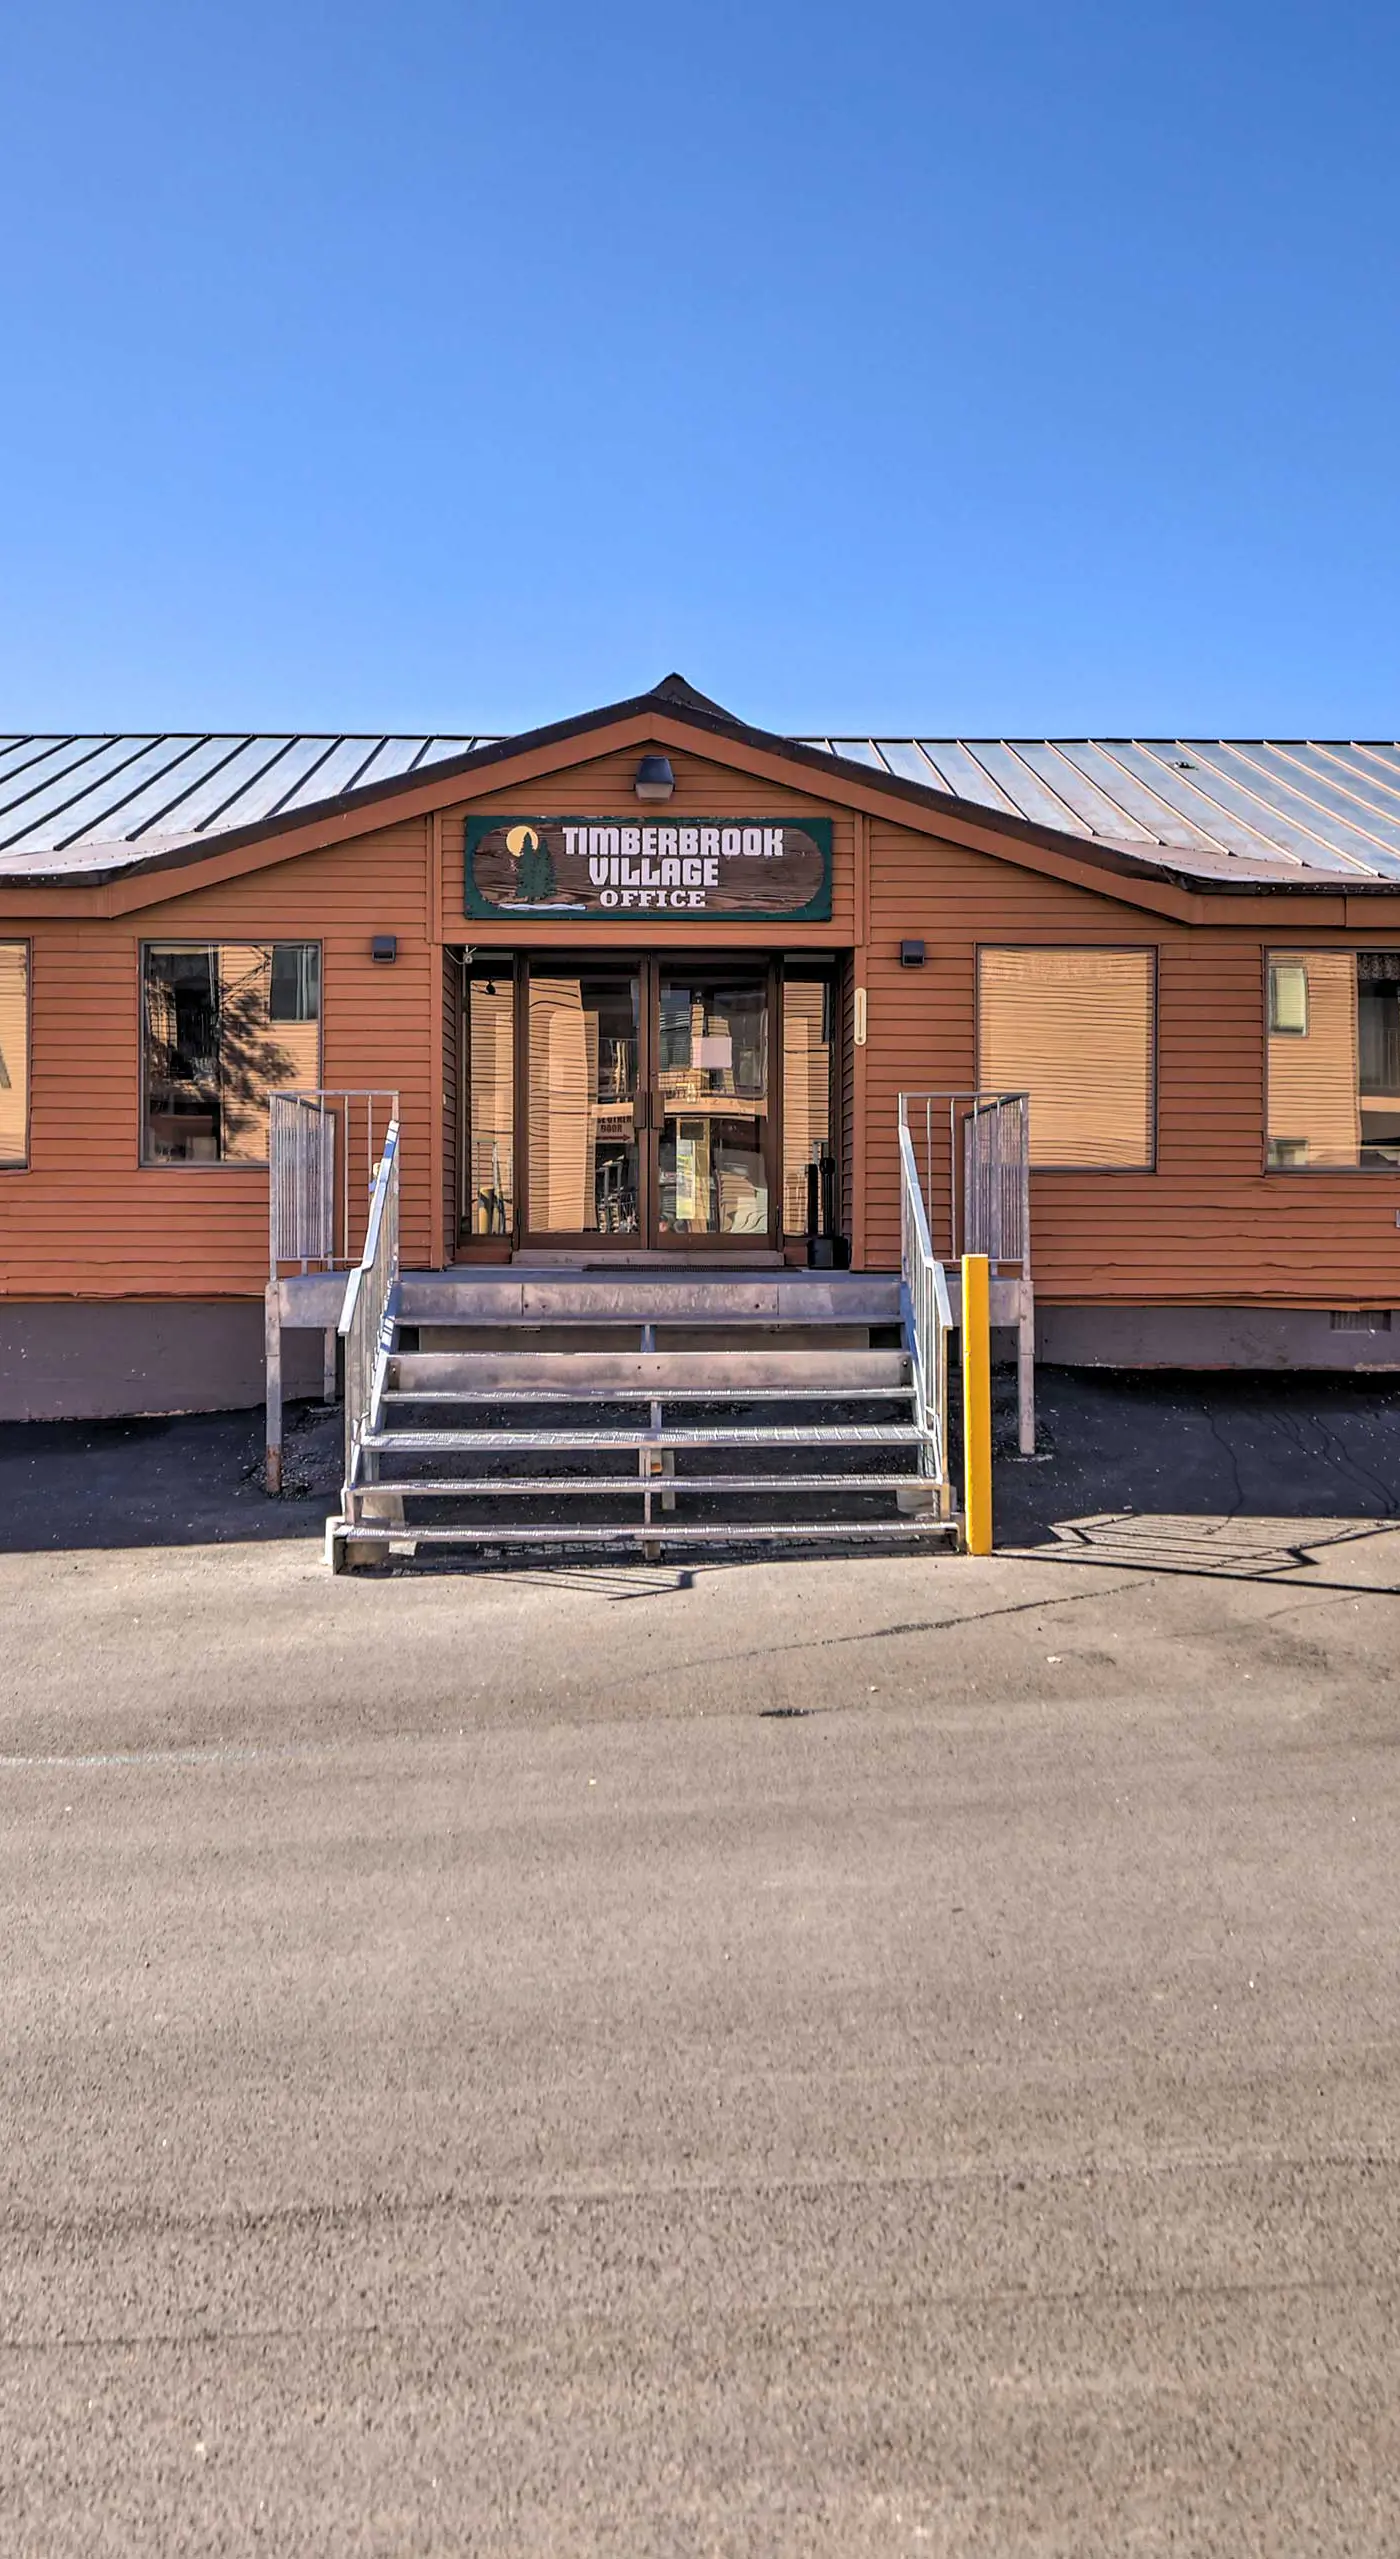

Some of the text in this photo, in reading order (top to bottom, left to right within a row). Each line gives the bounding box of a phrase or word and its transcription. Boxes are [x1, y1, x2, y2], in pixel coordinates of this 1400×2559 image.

[562, 827, 784, 856] TIMBERBROOK
[589, 858, 719, 886] VILLAGE
[600, 890, 706, 907] OFFICE
[600, 1124, 622, 1133] DOOR
